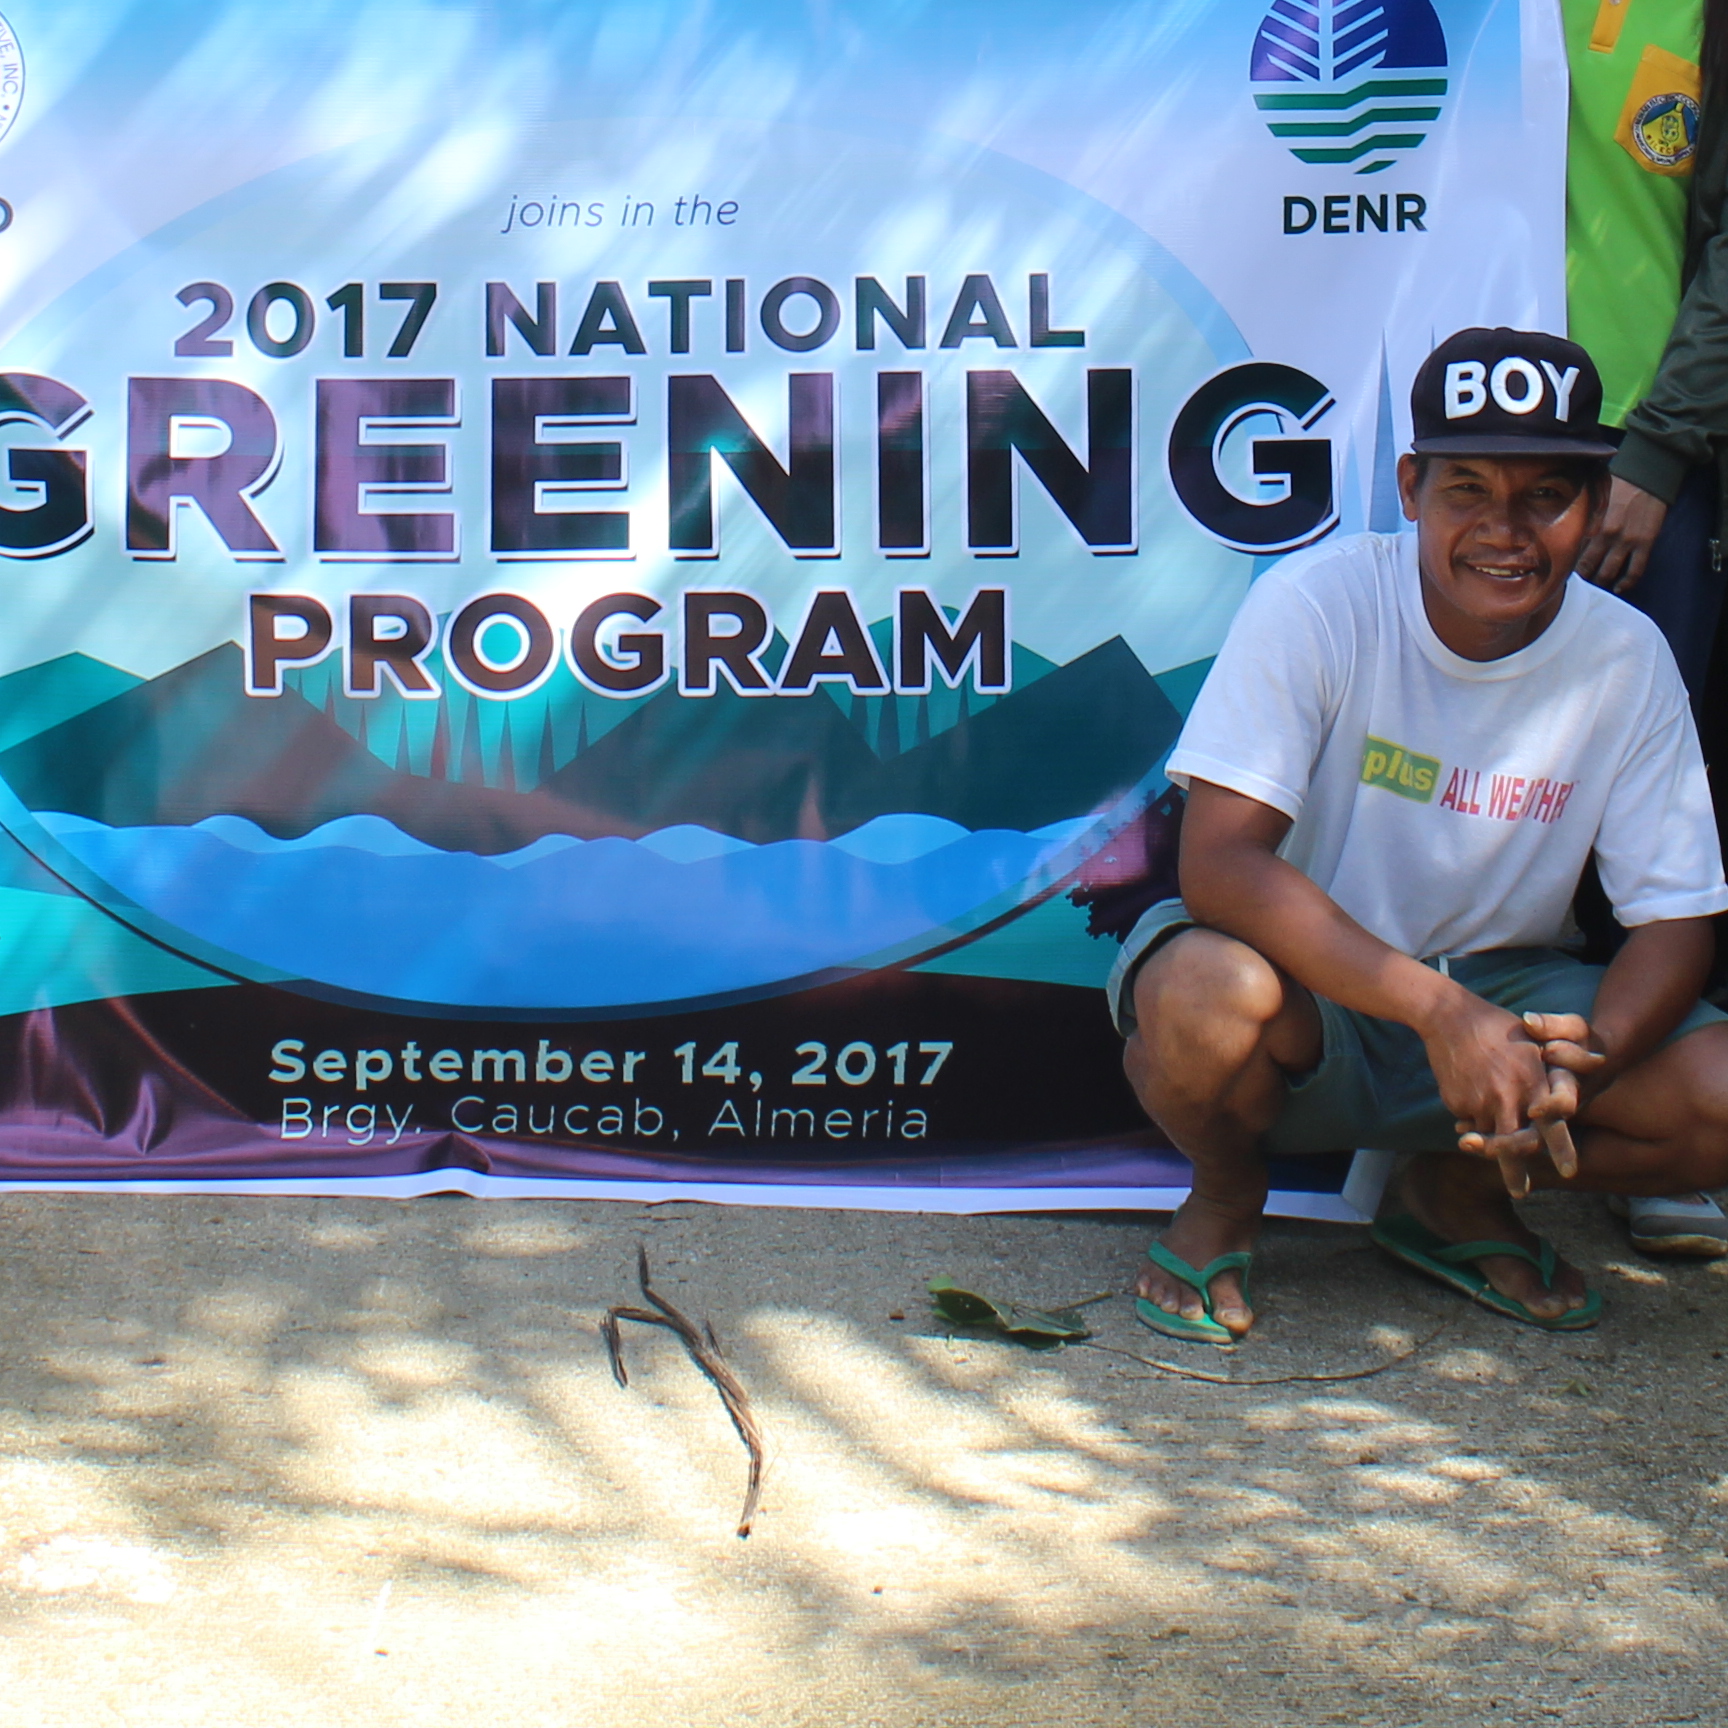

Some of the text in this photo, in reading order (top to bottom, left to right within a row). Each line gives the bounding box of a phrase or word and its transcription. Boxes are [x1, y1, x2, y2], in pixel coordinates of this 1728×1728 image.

[501, 194, 740, 234] joins in the
[1283, 194, 1427, 234] DENR
[174, 272, 1086, 358] 2017 NATIONAL
[1443, 356, 1581, 424] BOY
[246, 588, 1010, 696] PROGRAM
[1439, 766, 1481, 815] ALL
[268, 1038, 954, 1093] September 14, 2017
[280, 1095, 928, 1146] Brgy. Caucab, Almeria
